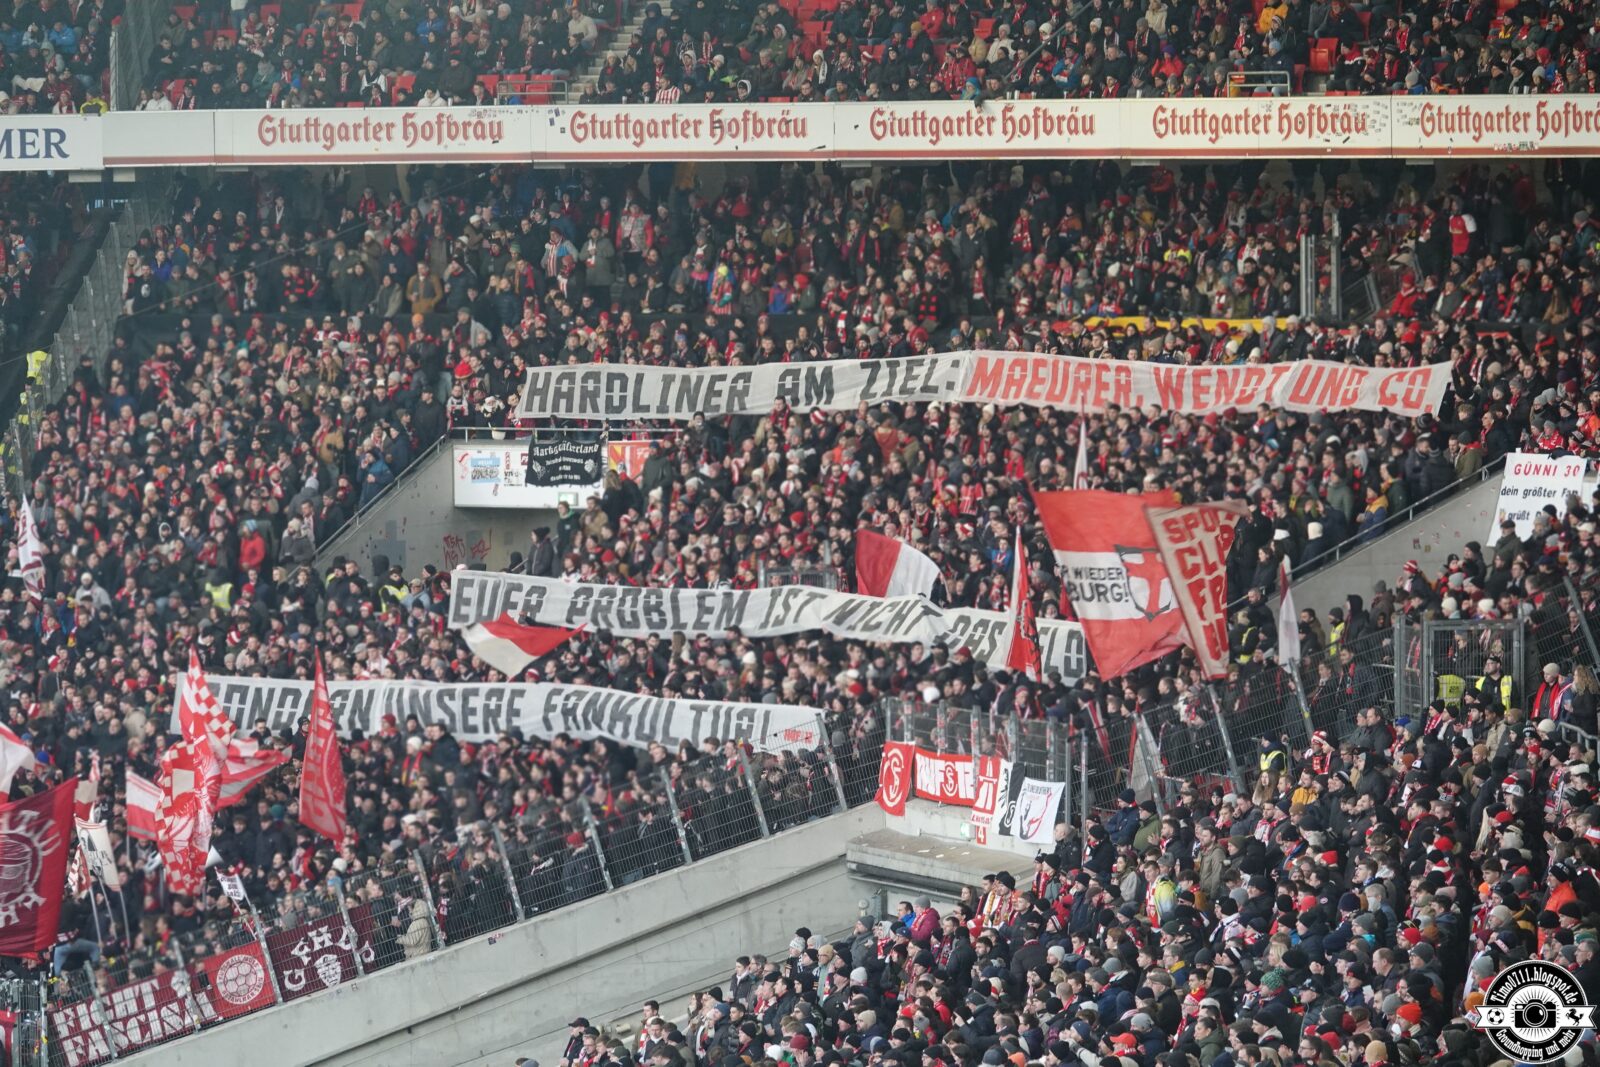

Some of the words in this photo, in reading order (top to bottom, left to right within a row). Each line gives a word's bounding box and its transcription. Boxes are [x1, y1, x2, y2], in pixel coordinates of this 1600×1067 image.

[258, 115, 395, 151] Stuttgarter
[570, 109, 702, 147] Stuttgarter
[708, 108, 807, 145] Hofbräu
[869, 106, 996, 145] Stuttgarter
[1001, 104, 1096, 142] Hofbräu
[1152, 104, 1273, 144] Stuttgarter
[1277, 103, 1368, 141] Hofbräu
[1420, 102, 1532, 144] Stuttgarter
[523, 371, 753, 415] HARDLINER
[776, 366, 835, 405] AM
[859, 359, 963, 400] ZIEL:
[1153, 365, 1291, 411] WENDT
[1288, 364, 1370, 407] UND
[1378, 373, 1434, 411] CO.
[1514, 461, 1558, 476] GÜNNI
[1564, 465, 1581, 477] 30
[1500, 485, 1519, 497] dein
[1523, 487, 1557, 499] größter
[1508, 510, 1530, 521] grüßt
[1072, 566, 1124, 580] WIEDER
[452, 578, 547, 625] EUER
[565, 587, 750, 630] PROBLEM
[758, 588, 827, 630] IST
[822, 599, 943, 636] NICHT
[932, 615, 1008, 664] DAS
[205, 682, 376, 738] ONDRN
[383, 687, 526, 735] UNSERE
[542, 688, 772, 748] FANKULTUR!
[53, 979, 160, 1039] FIGHT
